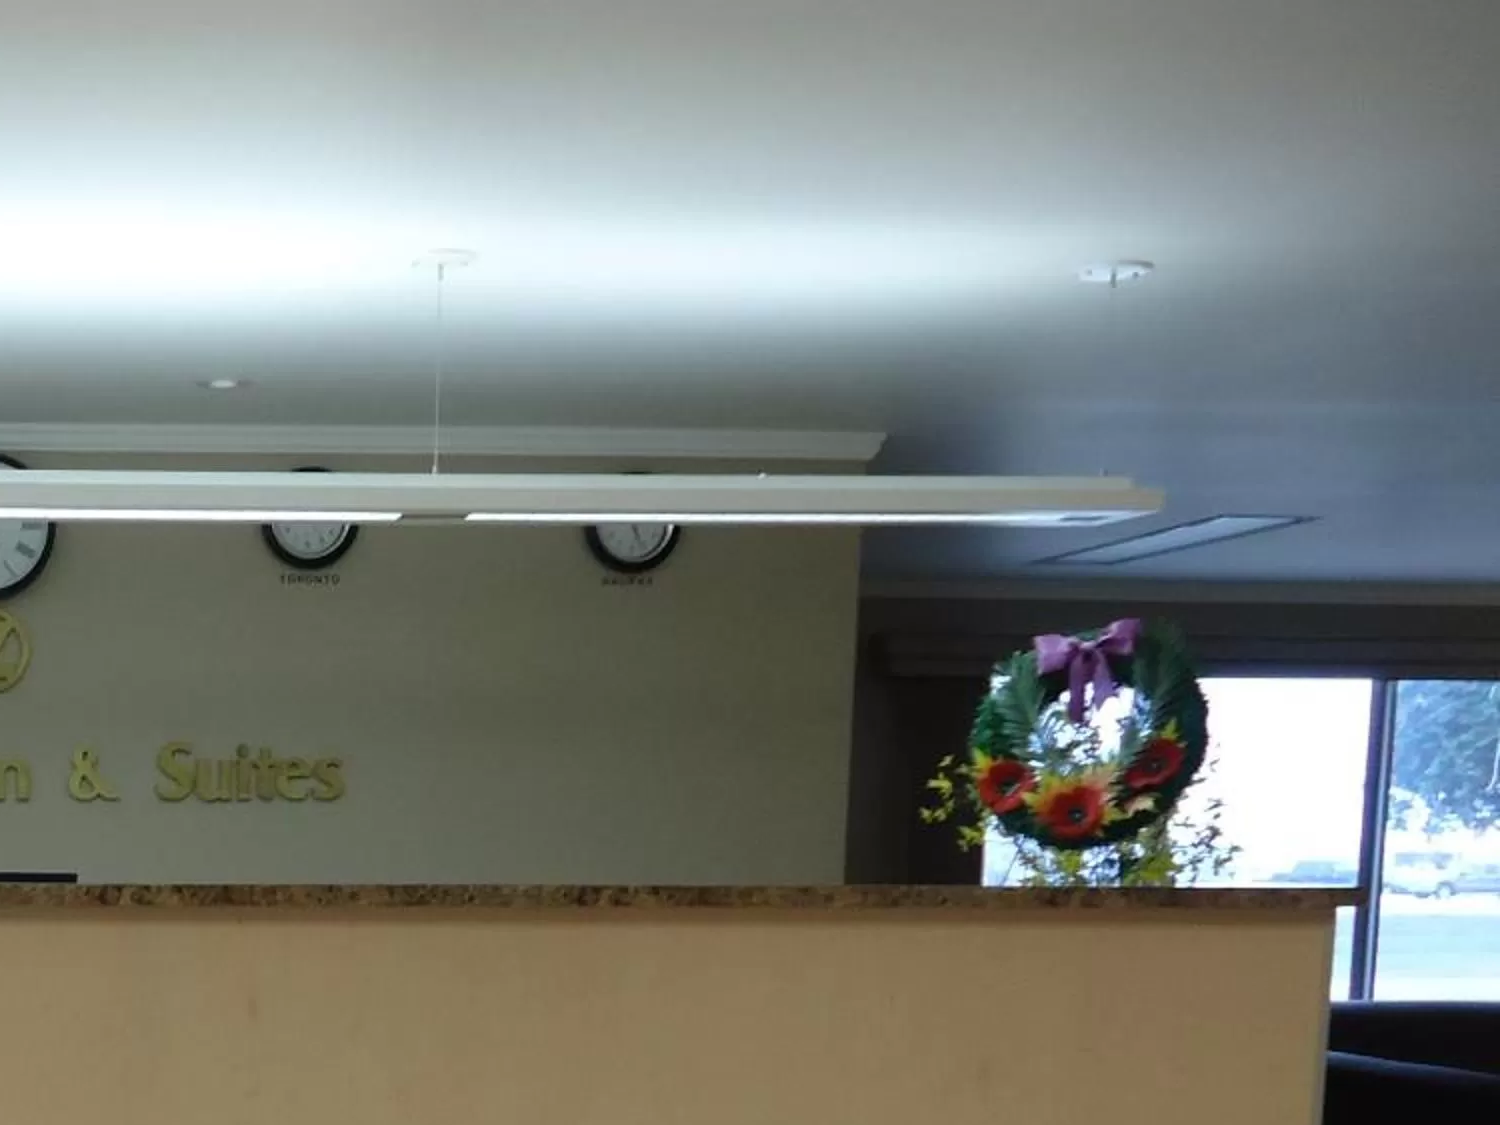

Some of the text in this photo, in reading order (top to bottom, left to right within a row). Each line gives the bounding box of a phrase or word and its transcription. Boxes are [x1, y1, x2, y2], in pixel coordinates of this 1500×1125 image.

[280, 574, 341, 585] TORONTO
[67, 744, 122, 803] &
[154, 741, 347, 803] Suites
